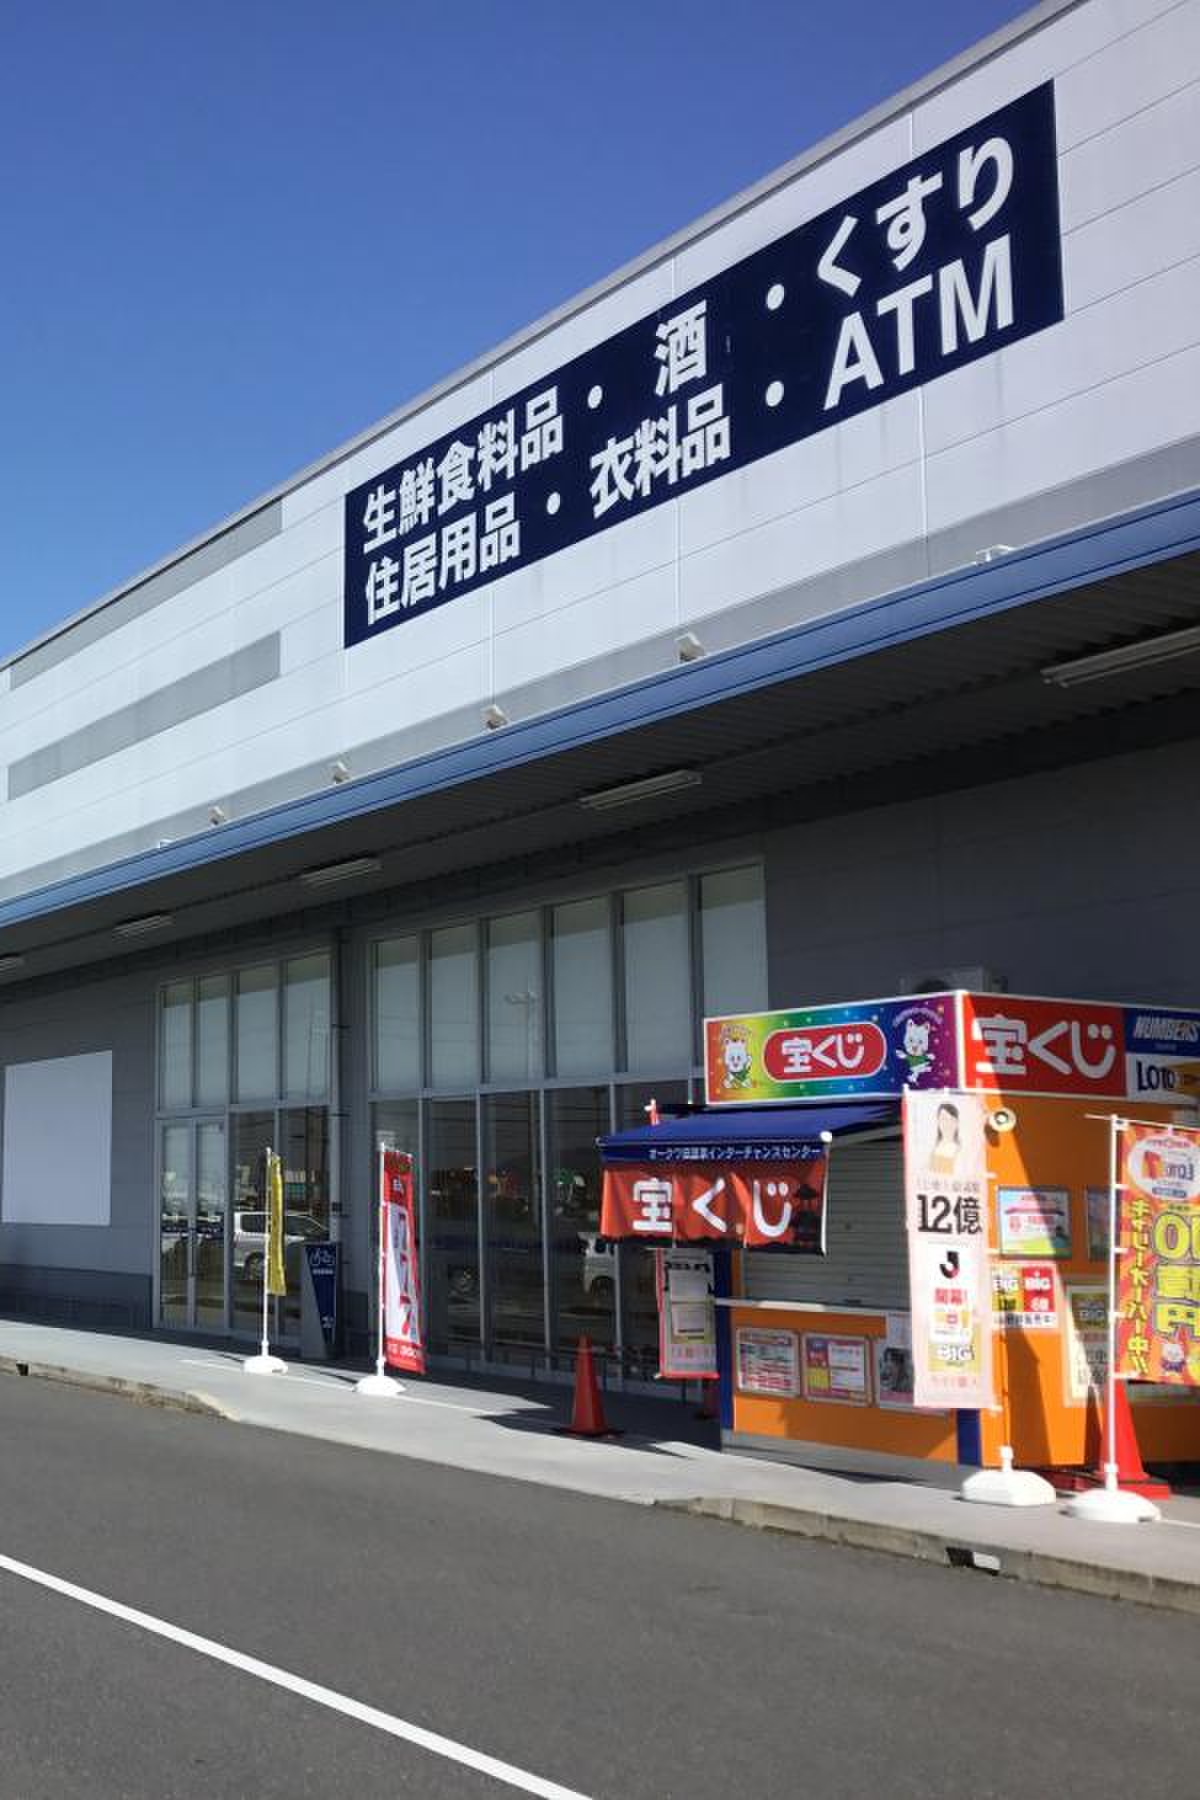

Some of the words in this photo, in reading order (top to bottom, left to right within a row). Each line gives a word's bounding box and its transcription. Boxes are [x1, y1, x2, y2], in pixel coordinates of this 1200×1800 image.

[781, 1034, 864, 1074] 宝くじ
[973, 1014, 1116, 1079] 宝くじ
[632, 1177, 792, 1238] 宝くじ
[916, 1194, 984, 1236] 12億
